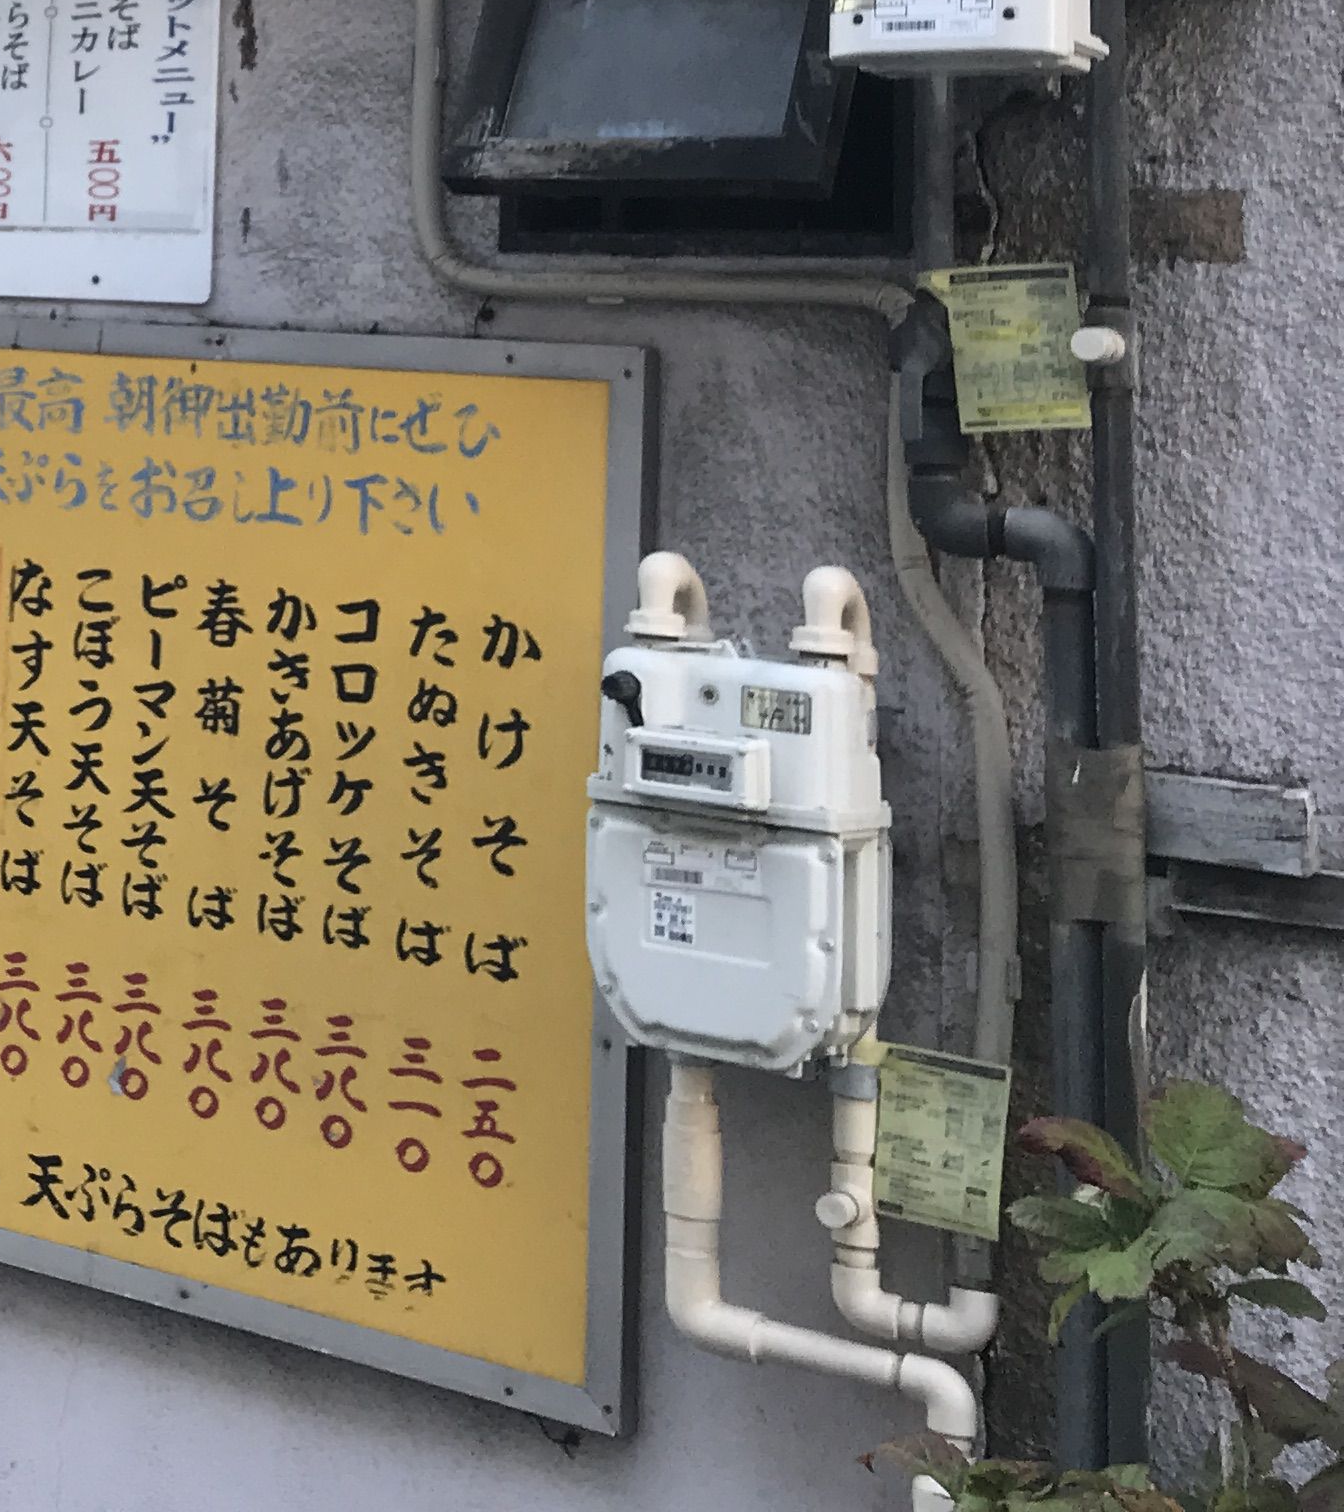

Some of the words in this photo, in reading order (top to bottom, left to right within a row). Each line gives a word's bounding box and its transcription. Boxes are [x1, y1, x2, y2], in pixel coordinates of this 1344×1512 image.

[1, 558, 54, 896] なす天そば
[121, 574, 188, 920] ピーマン天そば
[187, 578, 254, 930] 春菊そば
[257, 587, 317, 941] かきあげそば
[322, 599, 381, 949] コロッケそば
[396, 605, 459, 967] たぬきそば
[464, 613, 543, 983] かけそば
